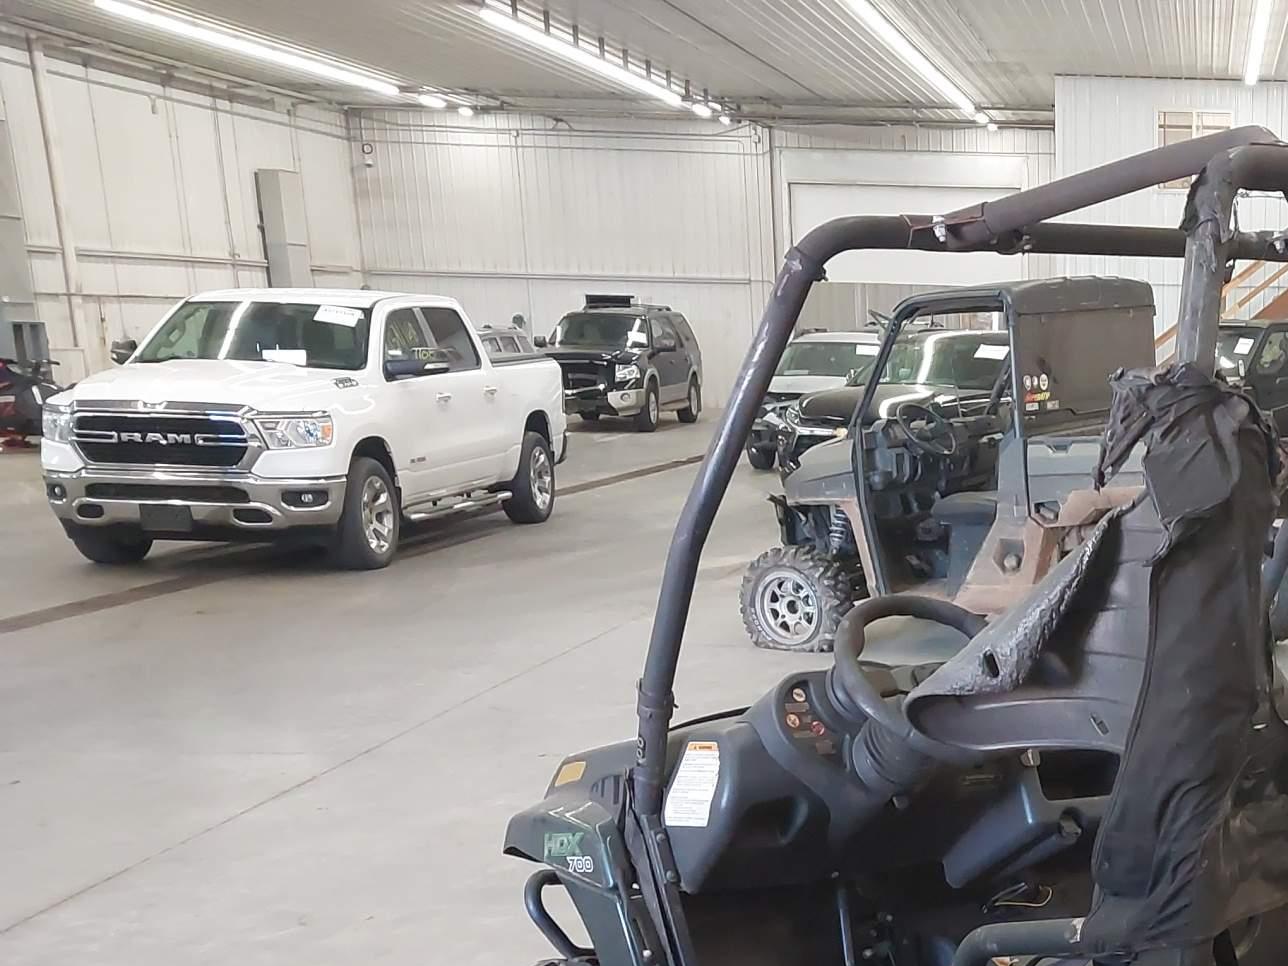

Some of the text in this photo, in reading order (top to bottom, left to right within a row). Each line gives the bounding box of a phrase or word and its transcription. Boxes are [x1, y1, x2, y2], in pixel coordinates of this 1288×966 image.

[120, 432, 192, 445] RAM
[544, 832, 584, 858] HDX
[566, 856, 594, 873] 700
